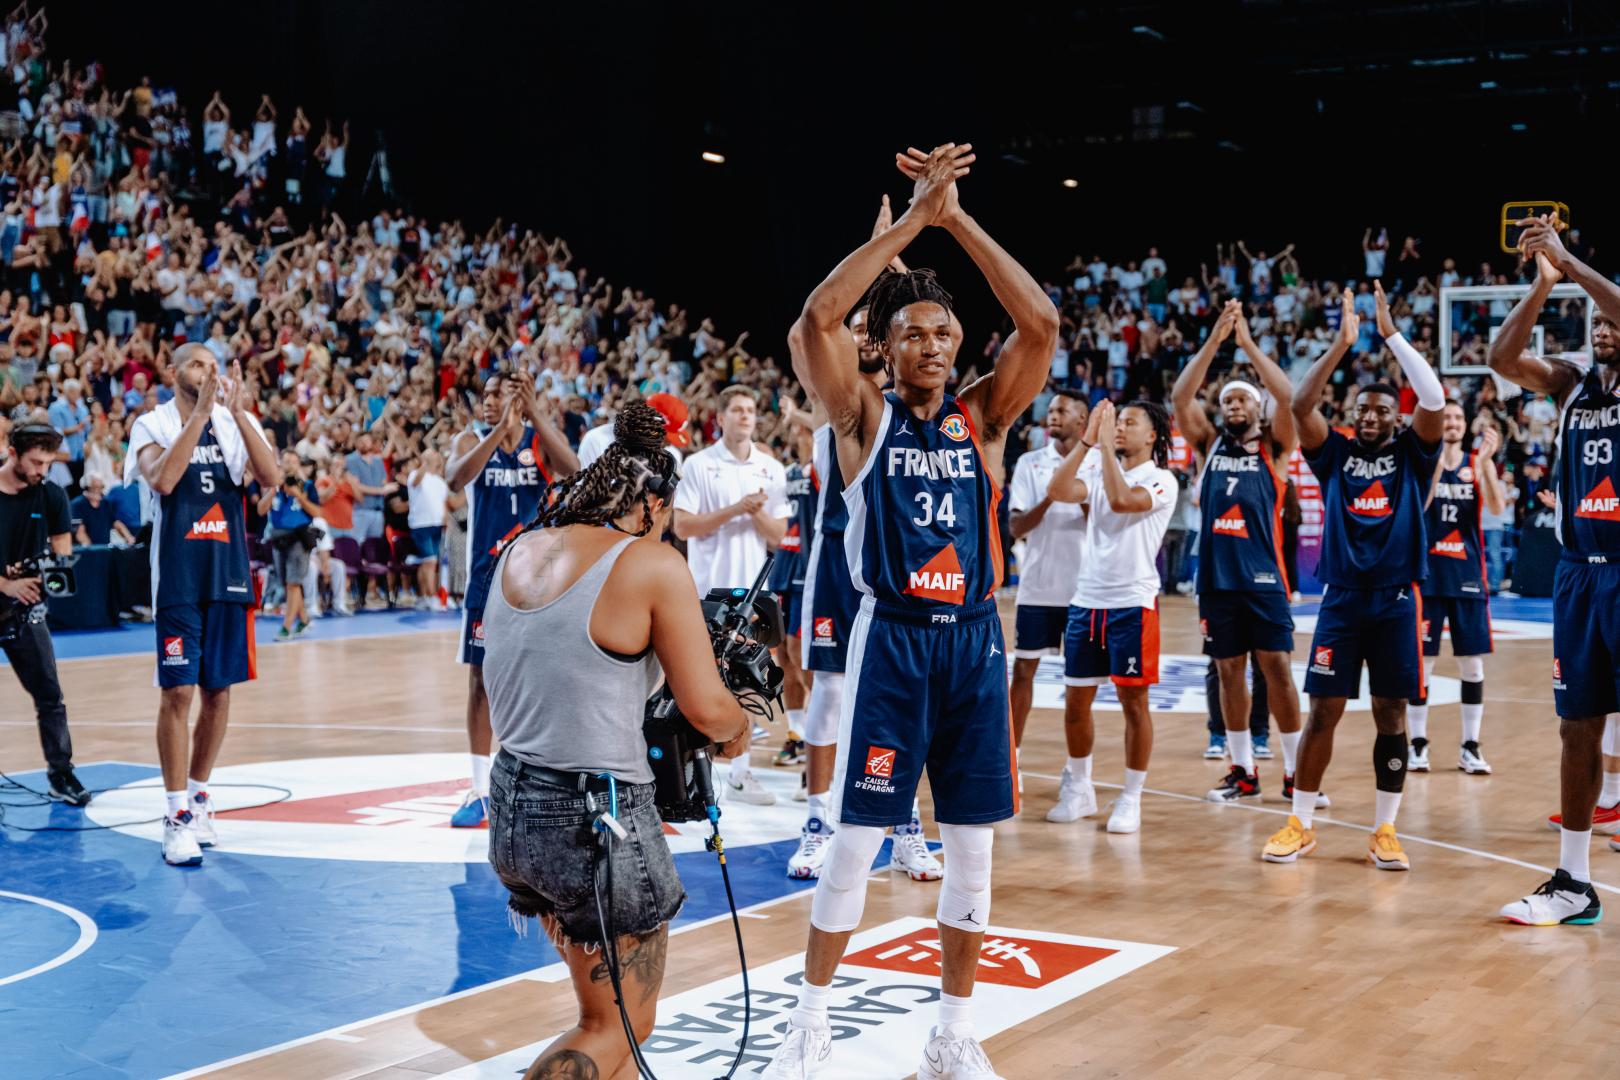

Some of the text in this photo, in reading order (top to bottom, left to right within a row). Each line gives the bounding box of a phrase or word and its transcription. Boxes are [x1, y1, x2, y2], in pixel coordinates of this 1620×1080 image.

[190, 444, 223, 464] ANC
[1583, 438, 1613, 466] 93
[887, 447, 976, 480] FRANCE
[1211, 454, 1259, 472] FRANCE
[1342, 454, 1397, 480] FRANCE
[200, 471, 215, 494] 5
[485, 466, 539, 488] FRANCE
[1226, 476, 1239, 496] 7
[1435, 483, 1474, 500] RANCE
[510, 493, 518, 516] 1
[913, 491, 957, 528] 34
[1354, 497, 1389, 510] MAIF
[1441, 503, 1459, 523] 12
[1581, 498, 1619, 513] MAIF
[193, 520, 228, 535] MAIF
[1215, 518, 1246, 531] MAIF
[1435, 541, 1465, 553] MAIF
[1587, 555, 1608, 564] FRA
[910, 571, 965, 591] MAIF
[931, 613, 957, 624] FRA
[854, 780, 896, 793] D'EPARGNE
[864, 776, 890, 786] CAISSE
